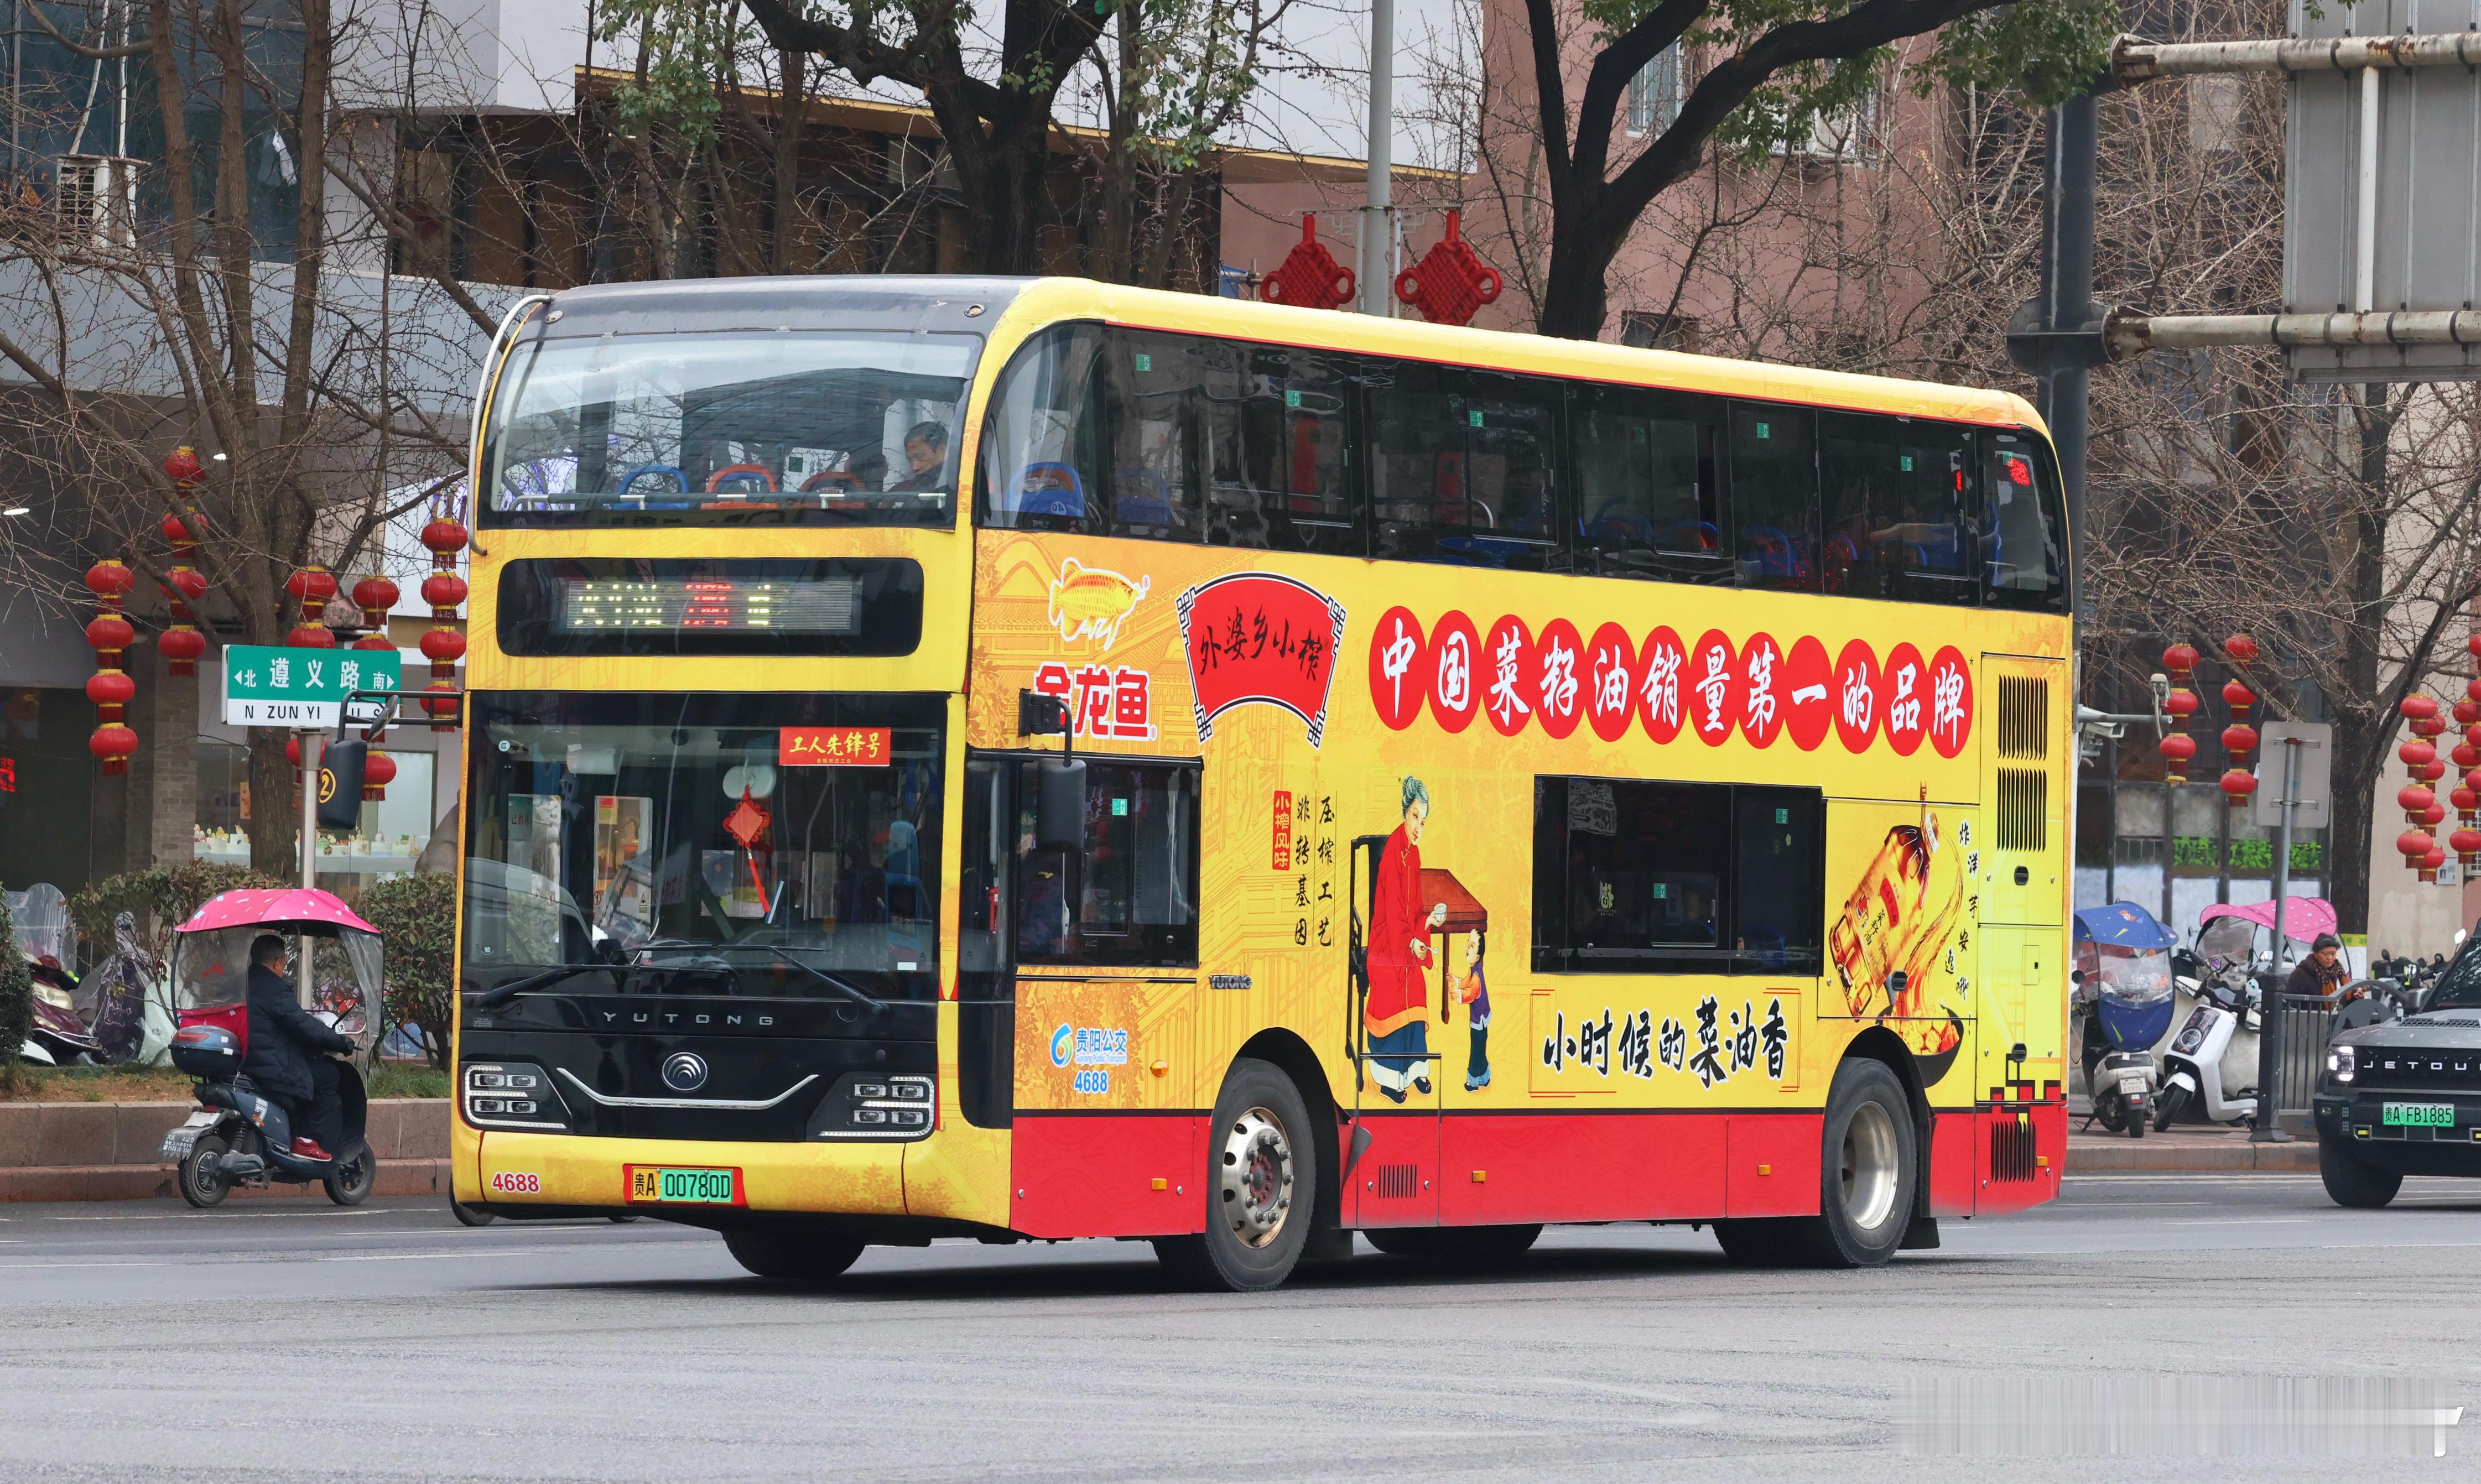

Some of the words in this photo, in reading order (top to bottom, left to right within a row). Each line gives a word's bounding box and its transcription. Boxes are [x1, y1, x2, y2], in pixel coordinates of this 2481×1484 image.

[244, 669, 257, 688] 北
[269, 657, 360, 690] 遵义路
[373, 671, 386, 690] 南
[1381, 617, 1965, 750] 中国菜籽油销量第一的品牌
[245, 705, 254, 718] N
[267, 705, 298, 719] ZUN
[306, 706, 320, 719] YI
[789, 731, 881, 758] 工人先锋号
[1275, 794, 1290, 868] 小榨风味
[1294, 795, 1311, 946] 非转基因
[1317, 795, 1335, 947] 压榨工艺
[1208, 975, 1252, 990] YUTONG
[603, 1012, 774, 1025] YUTONG
[1076, 1029, 1126, 1053] 贵阳公交
[1544, 996, 1787, 1087] 小时候的菜油香
[1076, 1054, 1093, 1064] Guiyang
[1093, 1054, 1105, 1063] Public
[1106, 1054, 1126, 1064] Transport
[2363, 1060, 2481, 1071] JETOU
[1075, 1071, 1107, 1092] 4688
[492, 1173, 540, 1193] 4688
